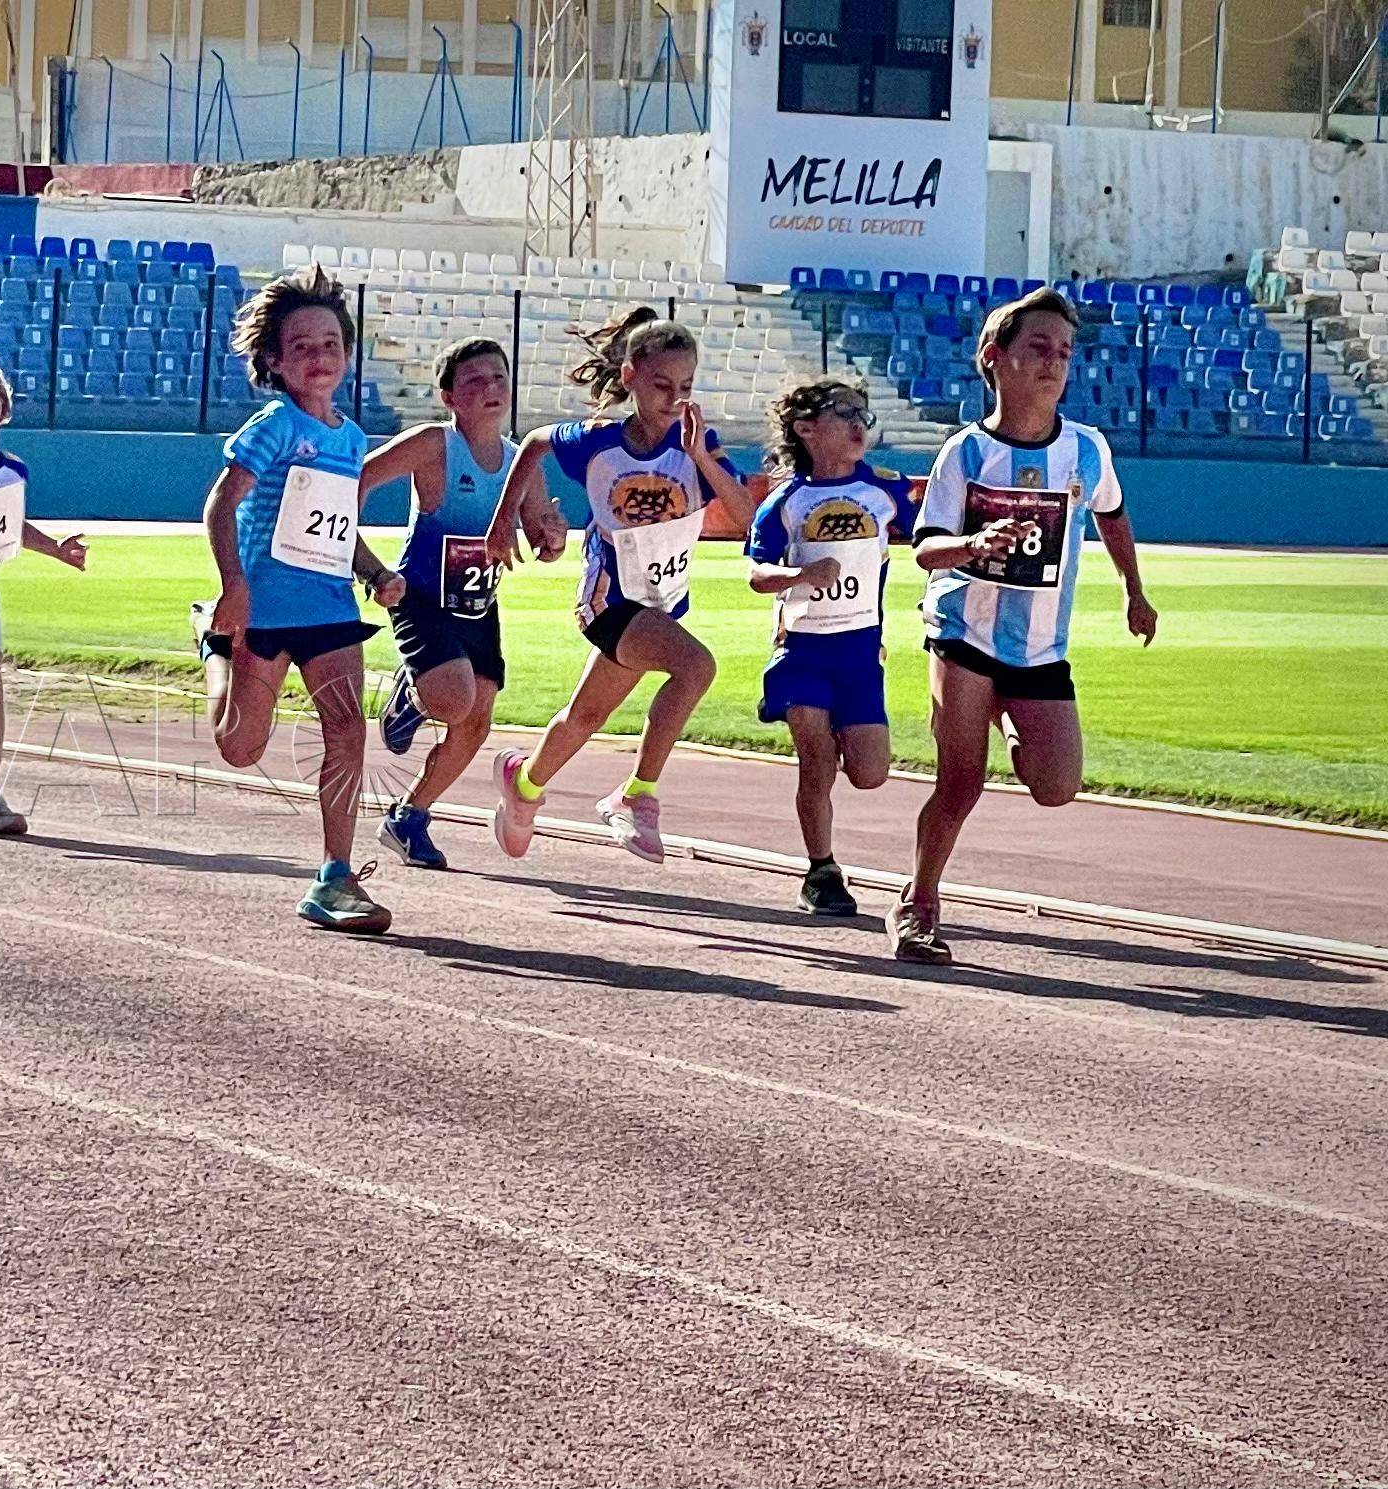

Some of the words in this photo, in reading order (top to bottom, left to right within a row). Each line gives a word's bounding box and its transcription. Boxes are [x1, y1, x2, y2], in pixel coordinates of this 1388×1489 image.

[783, 29, 838, 48] LOCAL
[896, 37, 948, 54] VISITANTE
[761, 154, 942, 209] MELILLA
[769, 214, 824, 231] CIUDAD
[828, 216, 852, 233] DEL
[861, 218, 925, 236] DEPORTE
[305, 510, 349, 541] 212
[648, 550, 688, 585] 345
